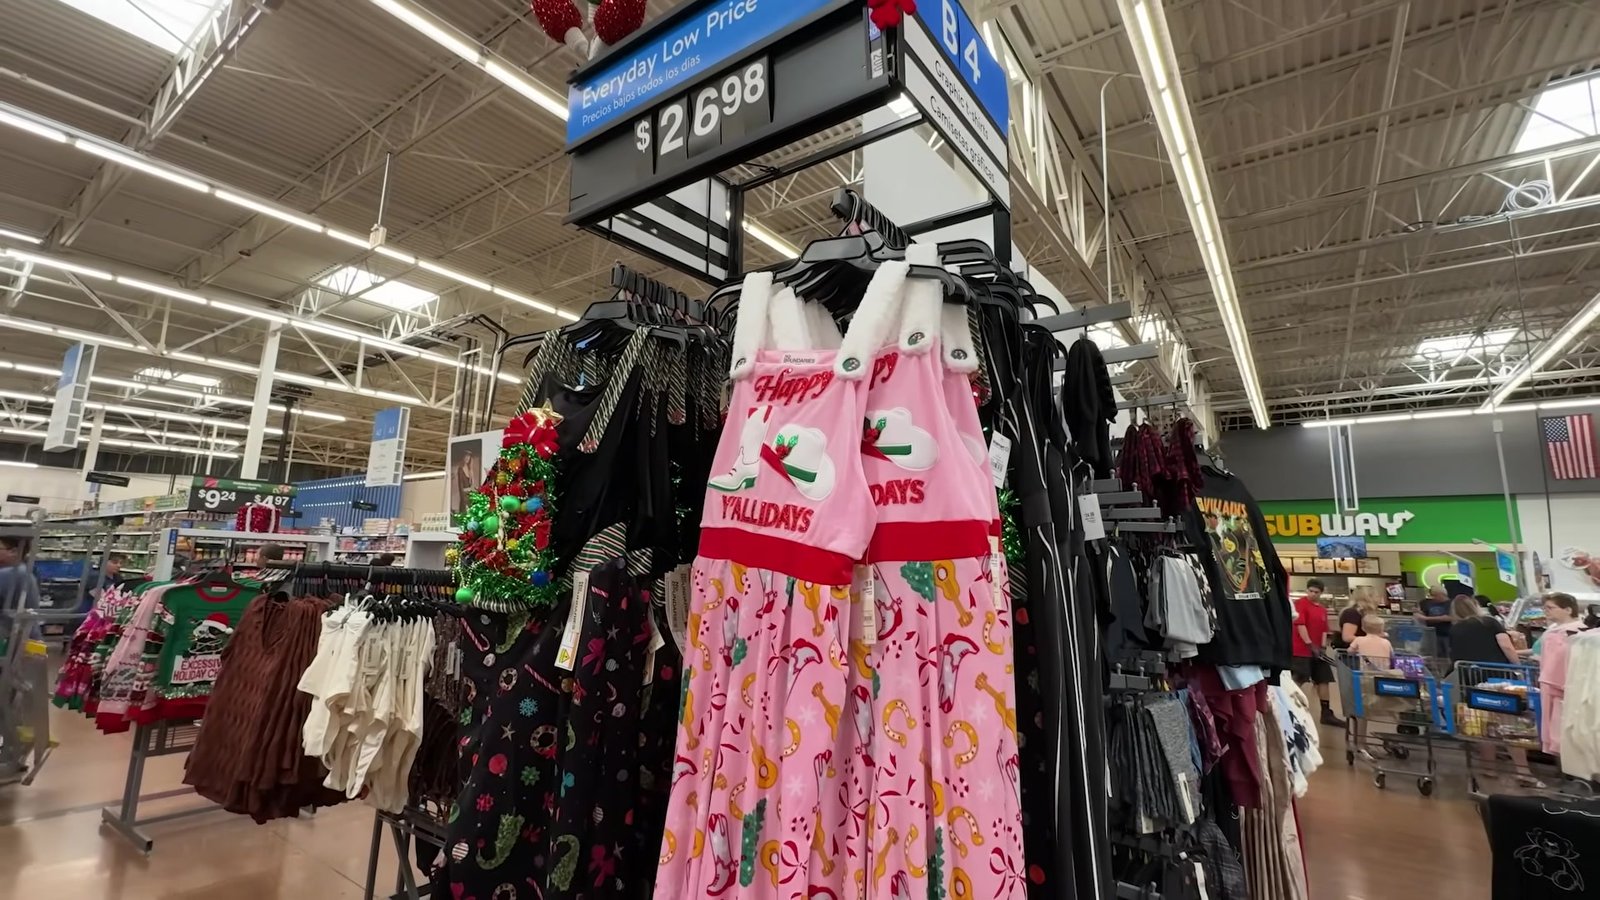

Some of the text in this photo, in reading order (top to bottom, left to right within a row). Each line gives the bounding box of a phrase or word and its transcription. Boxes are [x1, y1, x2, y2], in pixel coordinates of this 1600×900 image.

[582, 0, 758, 109] Everyday Low Price
[582, 54, 701, 127] Precios bajos todos los días
[934, 60, 990, 141] Graphic t-shirts
[930, 95, 996, 184] Camisetas gráficas
[754, 368, 835, 406] Happy
[868, 478, 925, 506] DAYS
[1203, 496, 1249, 518] VILLAINS
[721, 494, 814, 533] Y'ALLIDAYS
[1264, 510, 1415, 537] SUBWAY
[173, 668, 207, 681] HOLIDAY
[181, 658, 222, 671] EXCESSIV
